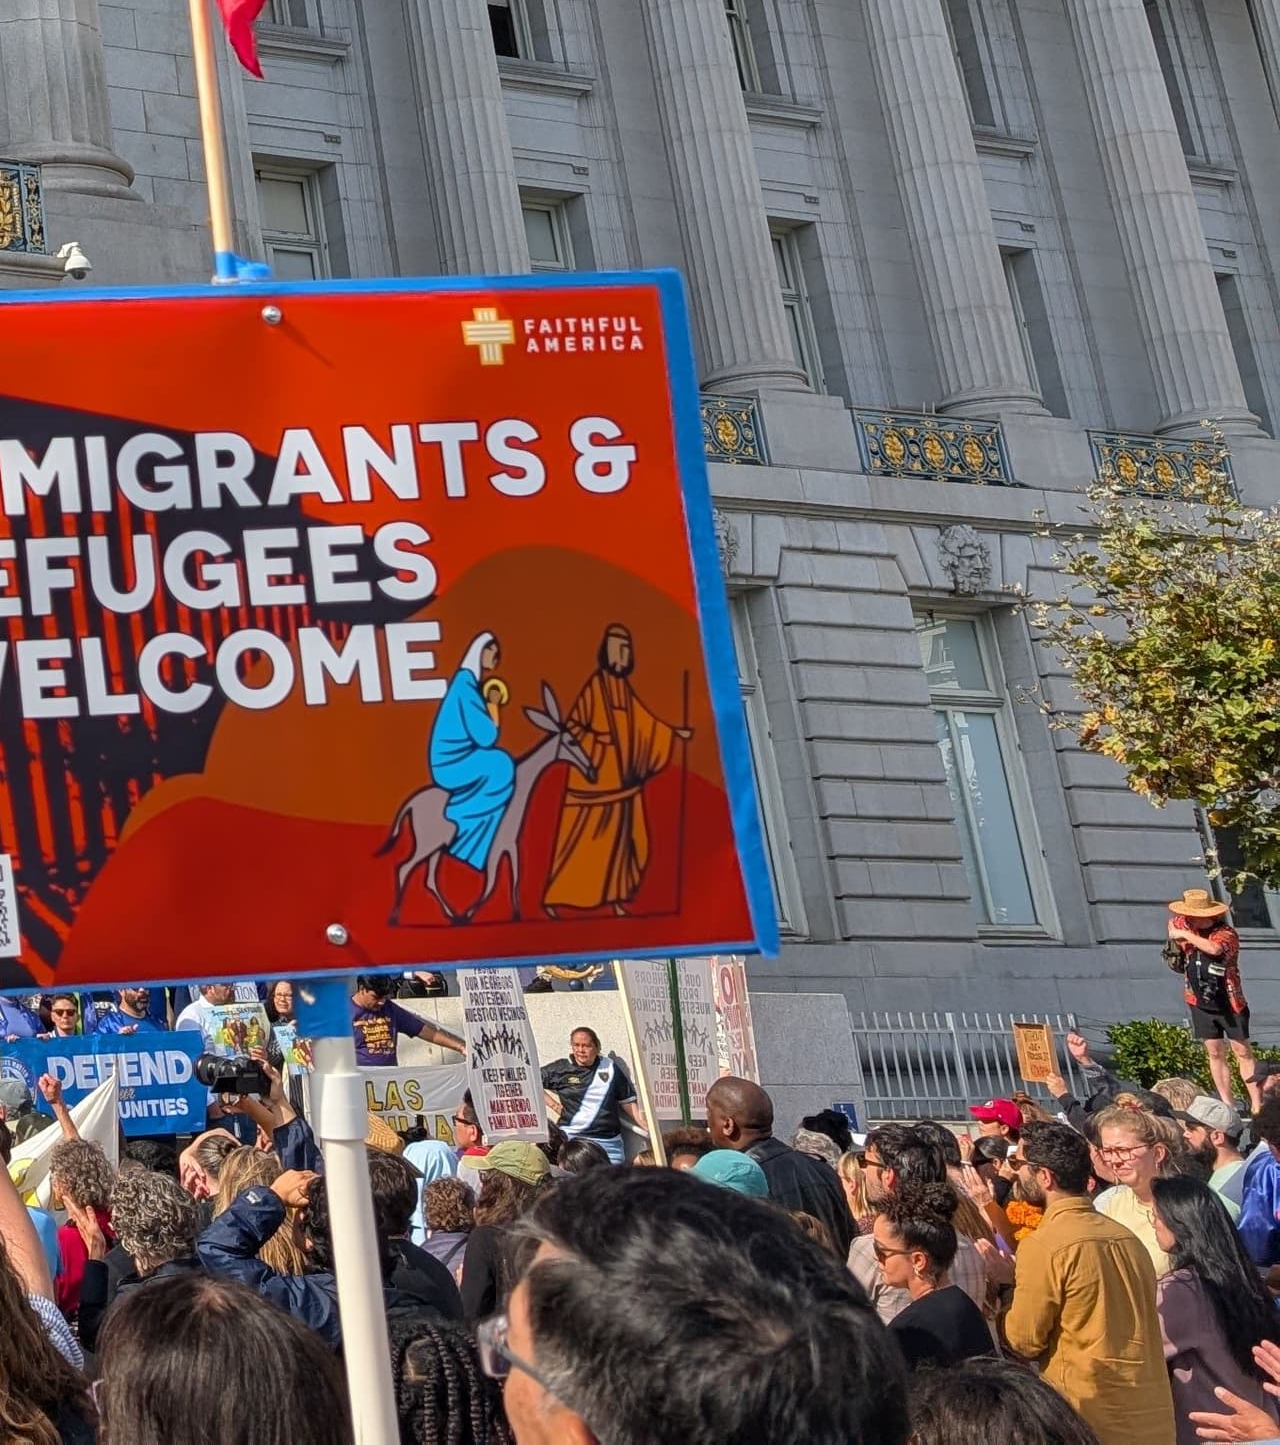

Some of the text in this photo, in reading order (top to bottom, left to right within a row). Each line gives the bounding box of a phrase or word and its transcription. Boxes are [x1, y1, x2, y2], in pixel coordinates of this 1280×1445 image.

[524, 316, 642, 334] FAITHFUL
[527, 335, 644, 353] AMERICA
[569, 416, 637, 494] &
[464, 977, 478, 991] OUR
[46, 1050, 193, 1091] DEFEND
[365, 1080, 424, 1111] LAS
[119, 1098, 189, 1120] UNITIES
